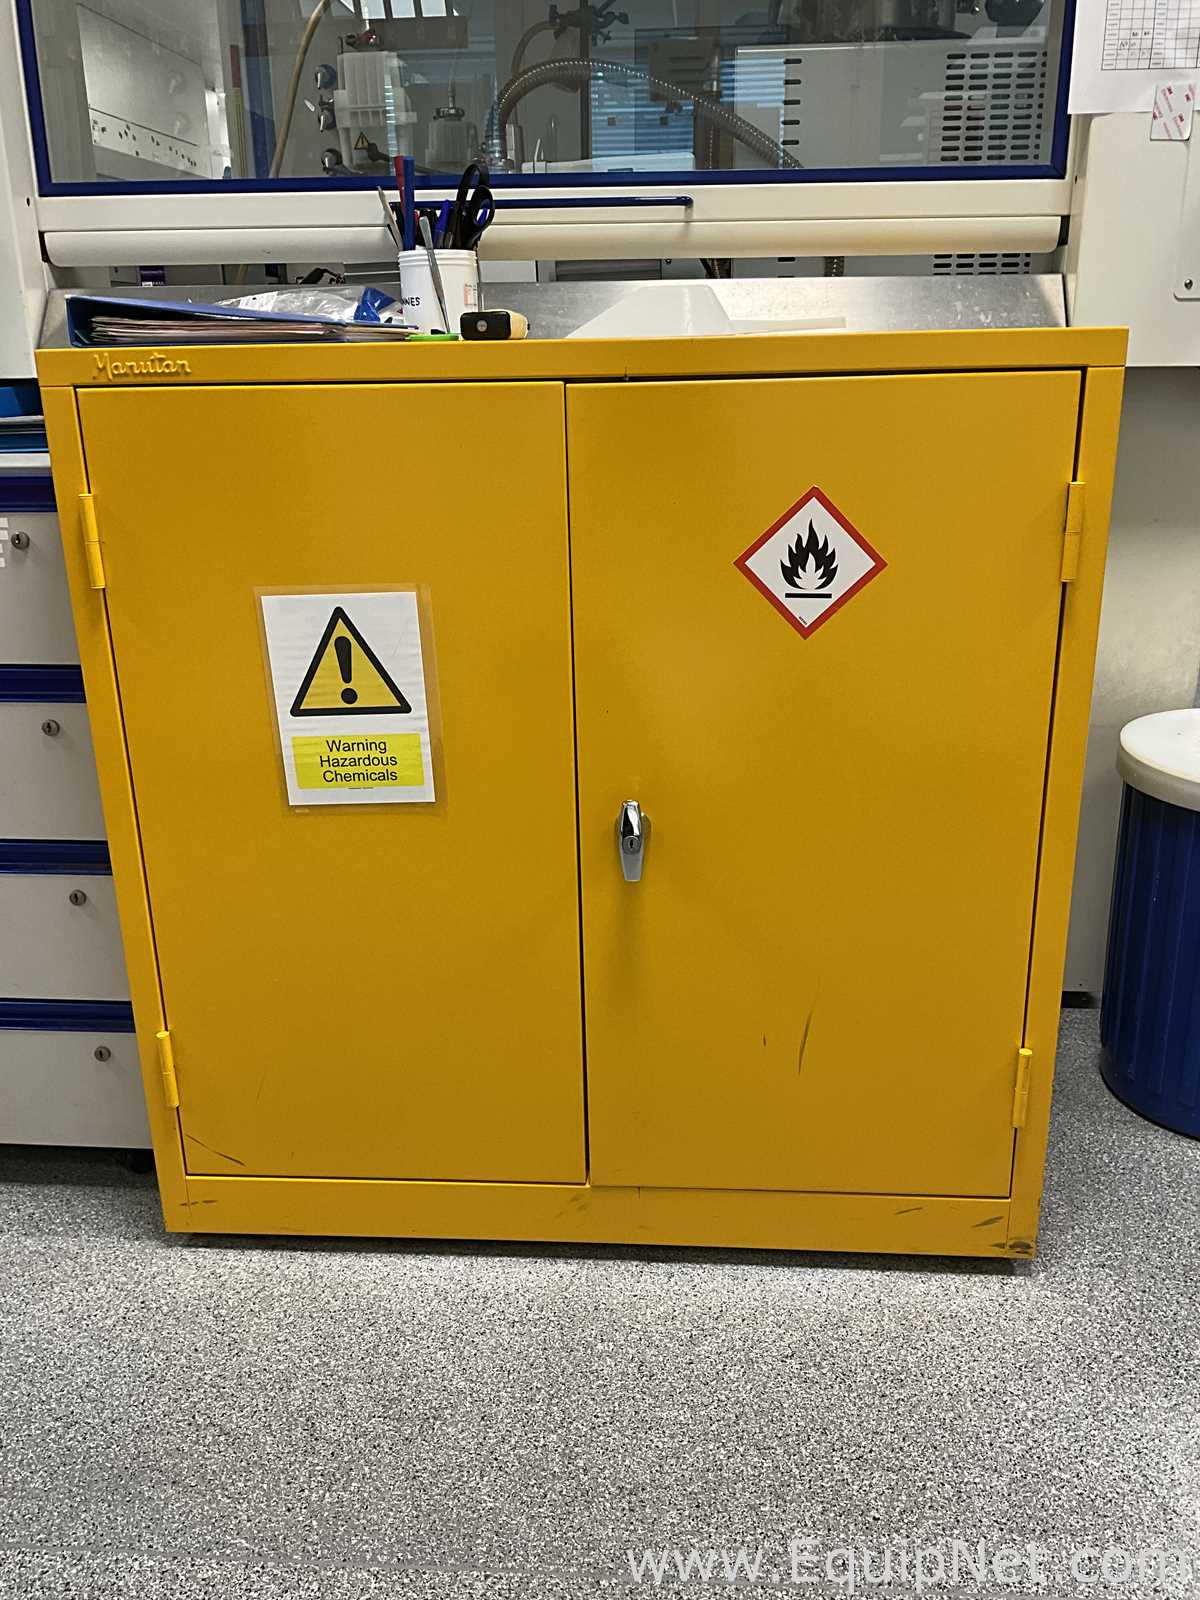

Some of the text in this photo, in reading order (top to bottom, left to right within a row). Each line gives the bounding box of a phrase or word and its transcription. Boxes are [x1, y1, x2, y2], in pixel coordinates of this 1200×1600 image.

[93, 352, 192, 381] Manutan
[326, 739, 387, 754] Warning
[319, 754, 398, 768] Hazardous
[322, 769, 398, 783] Chemicals
